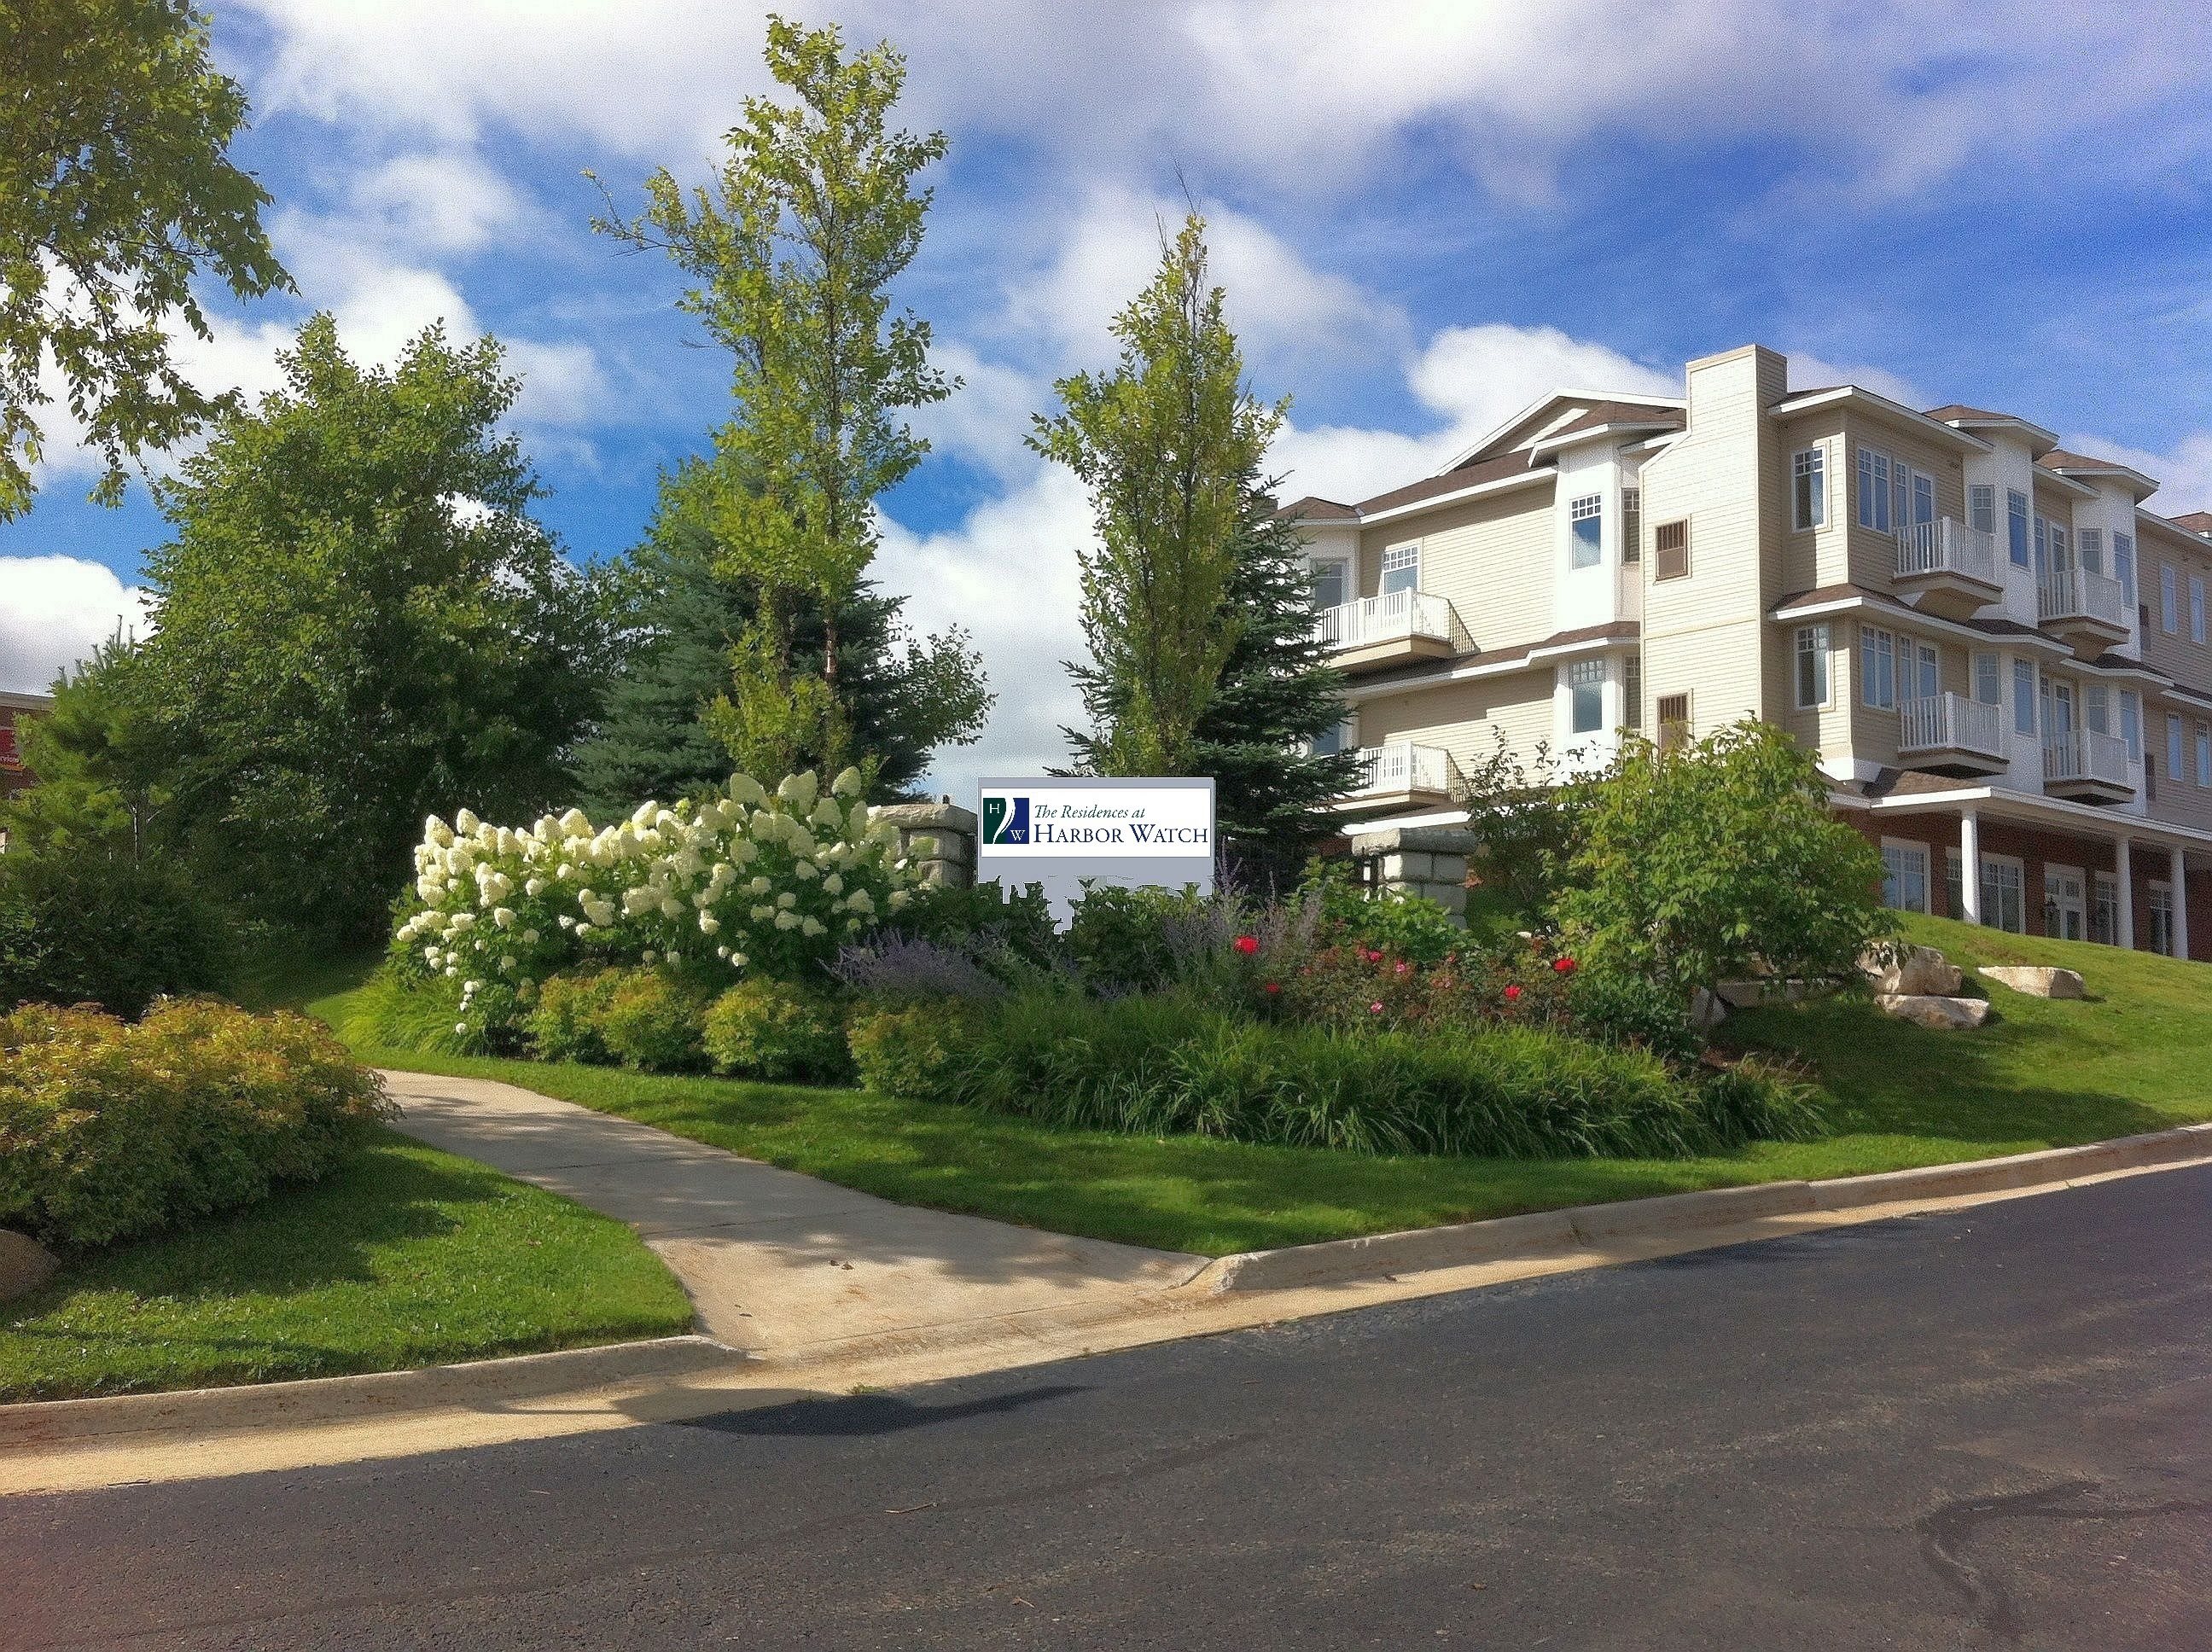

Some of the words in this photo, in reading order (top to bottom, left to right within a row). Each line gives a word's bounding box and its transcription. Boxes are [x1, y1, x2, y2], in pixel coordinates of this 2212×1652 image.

[989, 804, 1000, 814] H
[1034, 805, 1057, 818] The
[1061, 805, 1129, 818] Residences
[1132, 807, 1145, 818] at
[1010, 829, 1026, 841] W
[1033, 824, 1125, 843] HARBOR
[1129, 824, 1208, 843] WATCH
